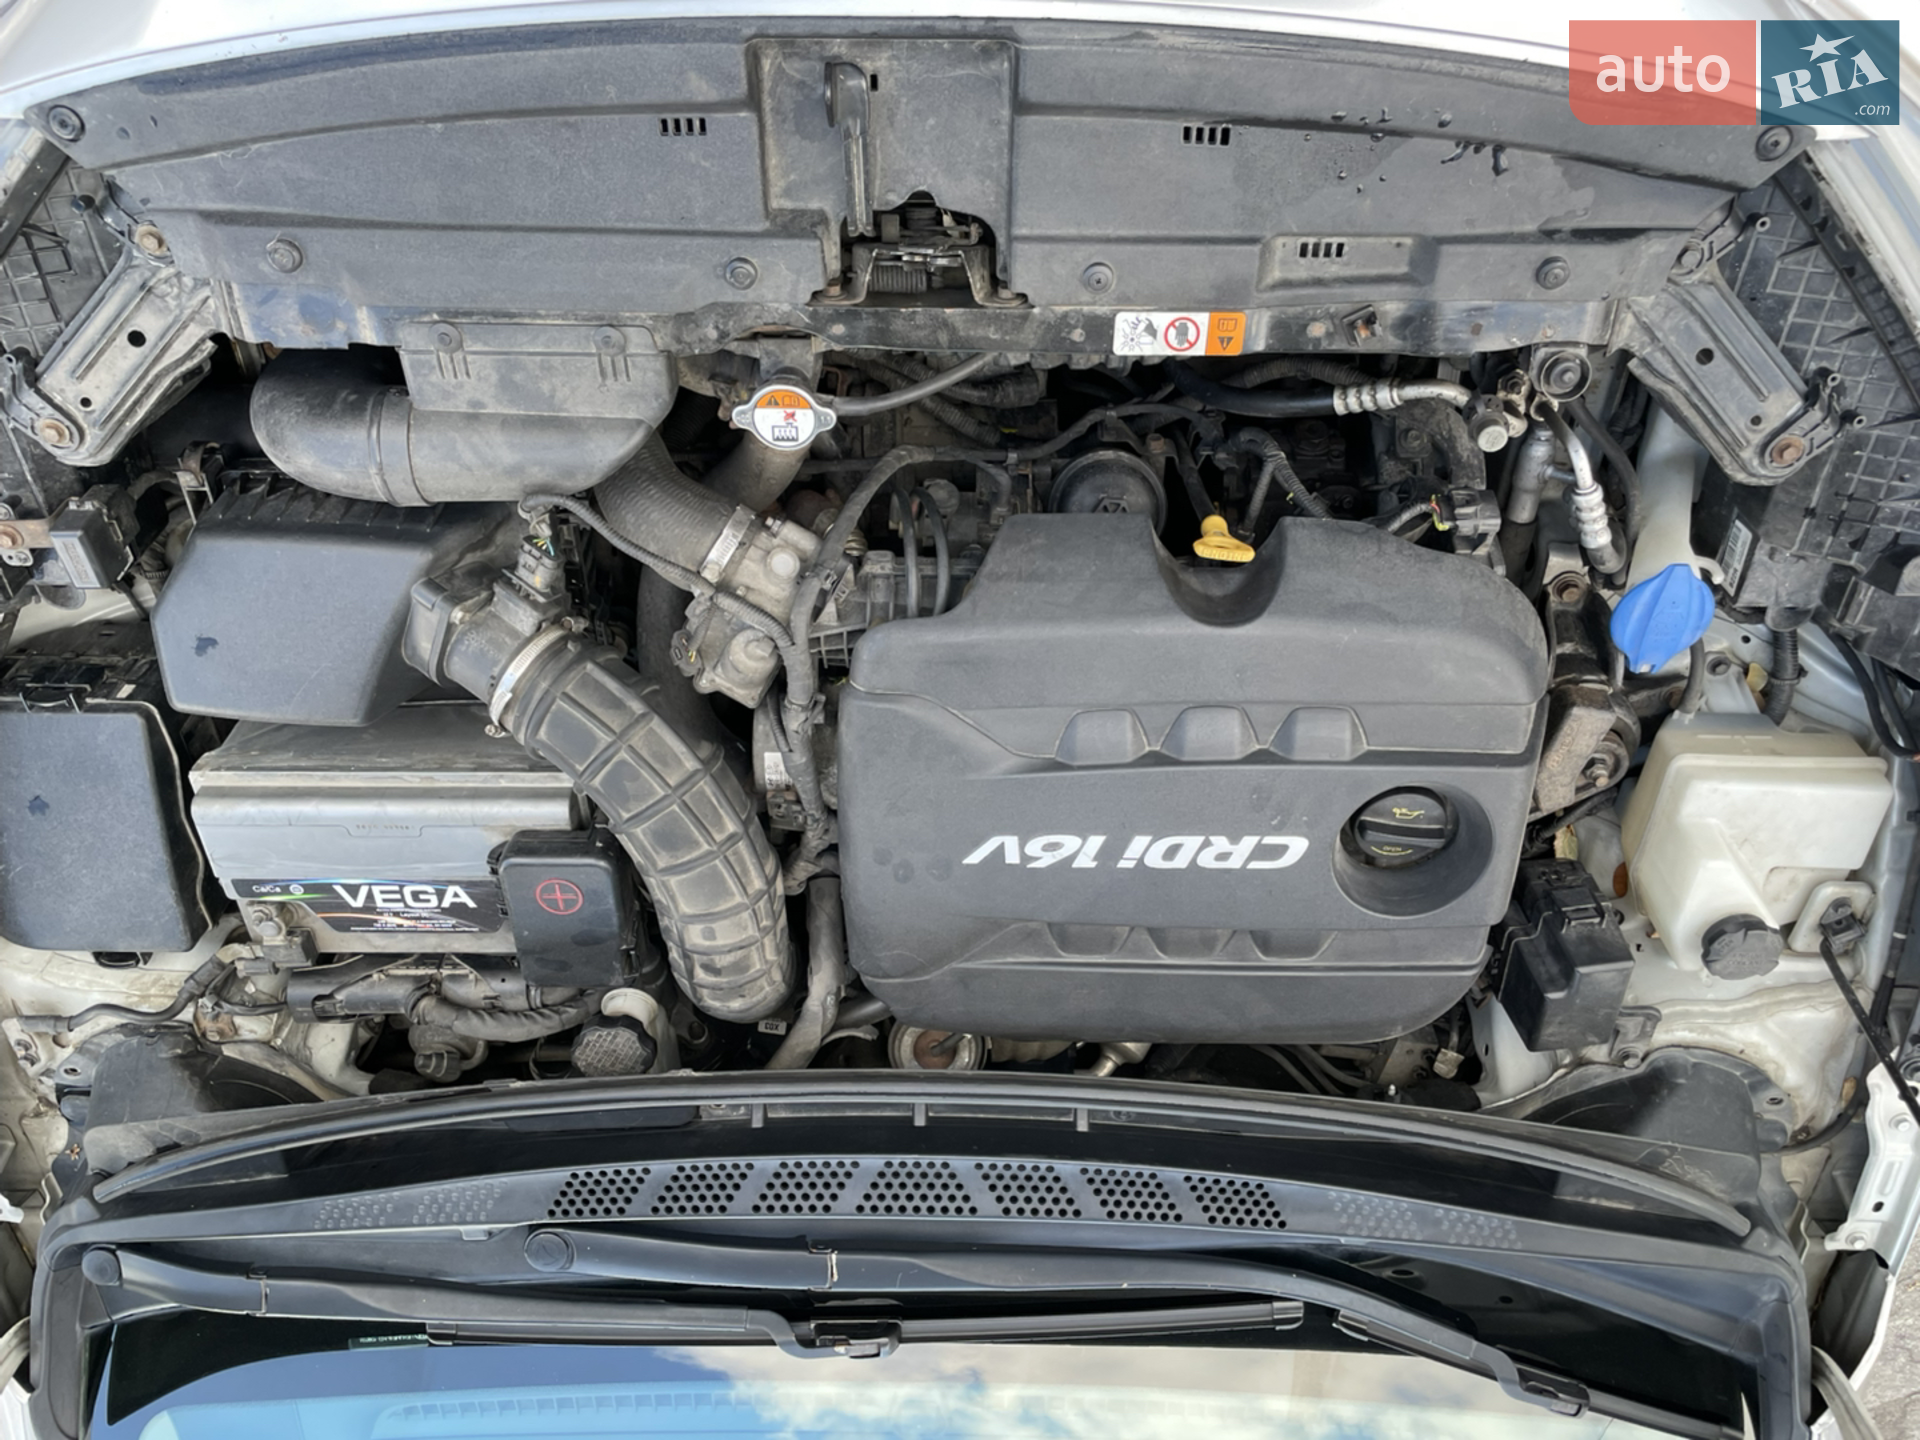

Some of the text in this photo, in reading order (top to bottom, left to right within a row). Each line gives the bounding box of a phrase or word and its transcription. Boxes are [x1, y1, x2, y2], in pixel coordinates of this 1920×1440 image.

[961, 834, 1310, 869] CRDi 16V
[332, 884, 477, 909] VEGA
